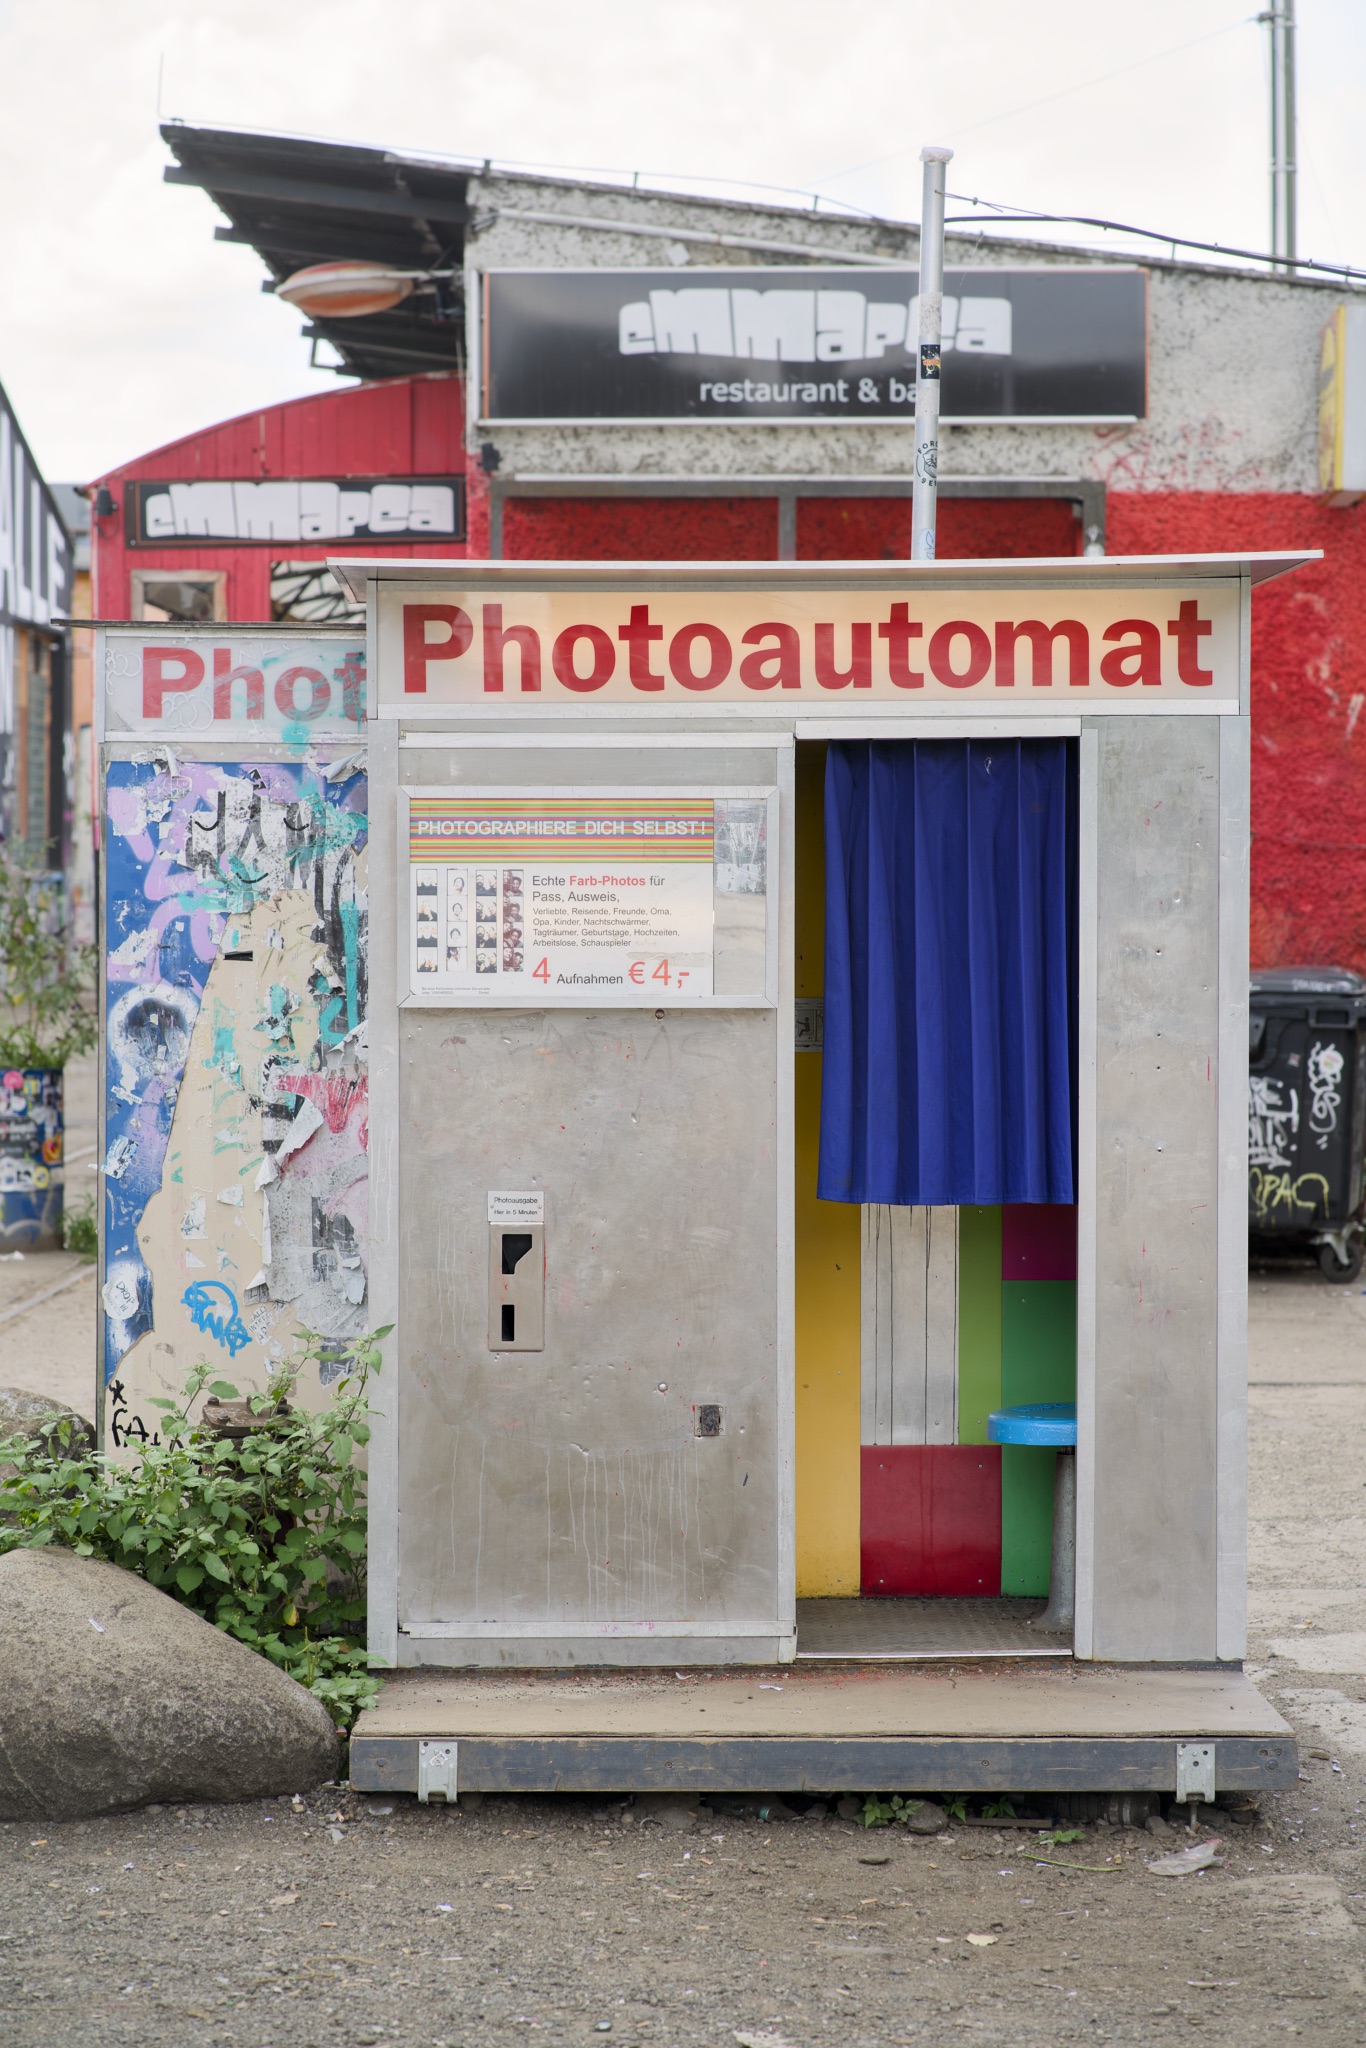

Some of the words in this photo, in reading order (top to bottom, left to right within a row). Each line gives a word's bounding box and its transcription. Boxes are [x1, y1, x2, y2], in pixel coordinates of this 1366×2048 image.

[700, 378, 849, 403] restaurant
[858, 380, 880, 403] &
[889, 377, 917, 403] ba
[403, 600, 1213, 694] Photoautomat
[418, 820, 577, 836] PHOTOGRAPHIERE
[585, 820, 624, 836] DICH
[632, 820, 706, 836] SELBST!
[532, 875, 566, 886] Echte
[569, 875, 646, 886] Farb-Photos
[649, 875, 665, 886] für
[532, 891, 565, 903] Pass,
[567, 891, 620, 903] Ausweis,
[532, 907, 569, 916] Verliebte,
[571, 907, 611, 916] Reisende,
[613, 907, 648, 916] Freunde,
[650, 907, 672, 916] Oma,
[532, 918, 552, 927] Opa,
[554, 918, 582, 927] Kinder,
[583, 917, 651, 927] Nachtschwärmer,
[532, 928, 579, 938] Tagträumer,
[581, 928, 632, 938] Geburtstage,
[633, 928, 680, 938] Hochzeiten,
[532, 939, 579, 948] Arbeitslose,
[580, 939, 632, 949] Schauspieler
[532, 957, 551, 984] 4
[556, 973, 623, 985] Aufnahmen
[494, 1196, 538, 1205] Photoausgabe
